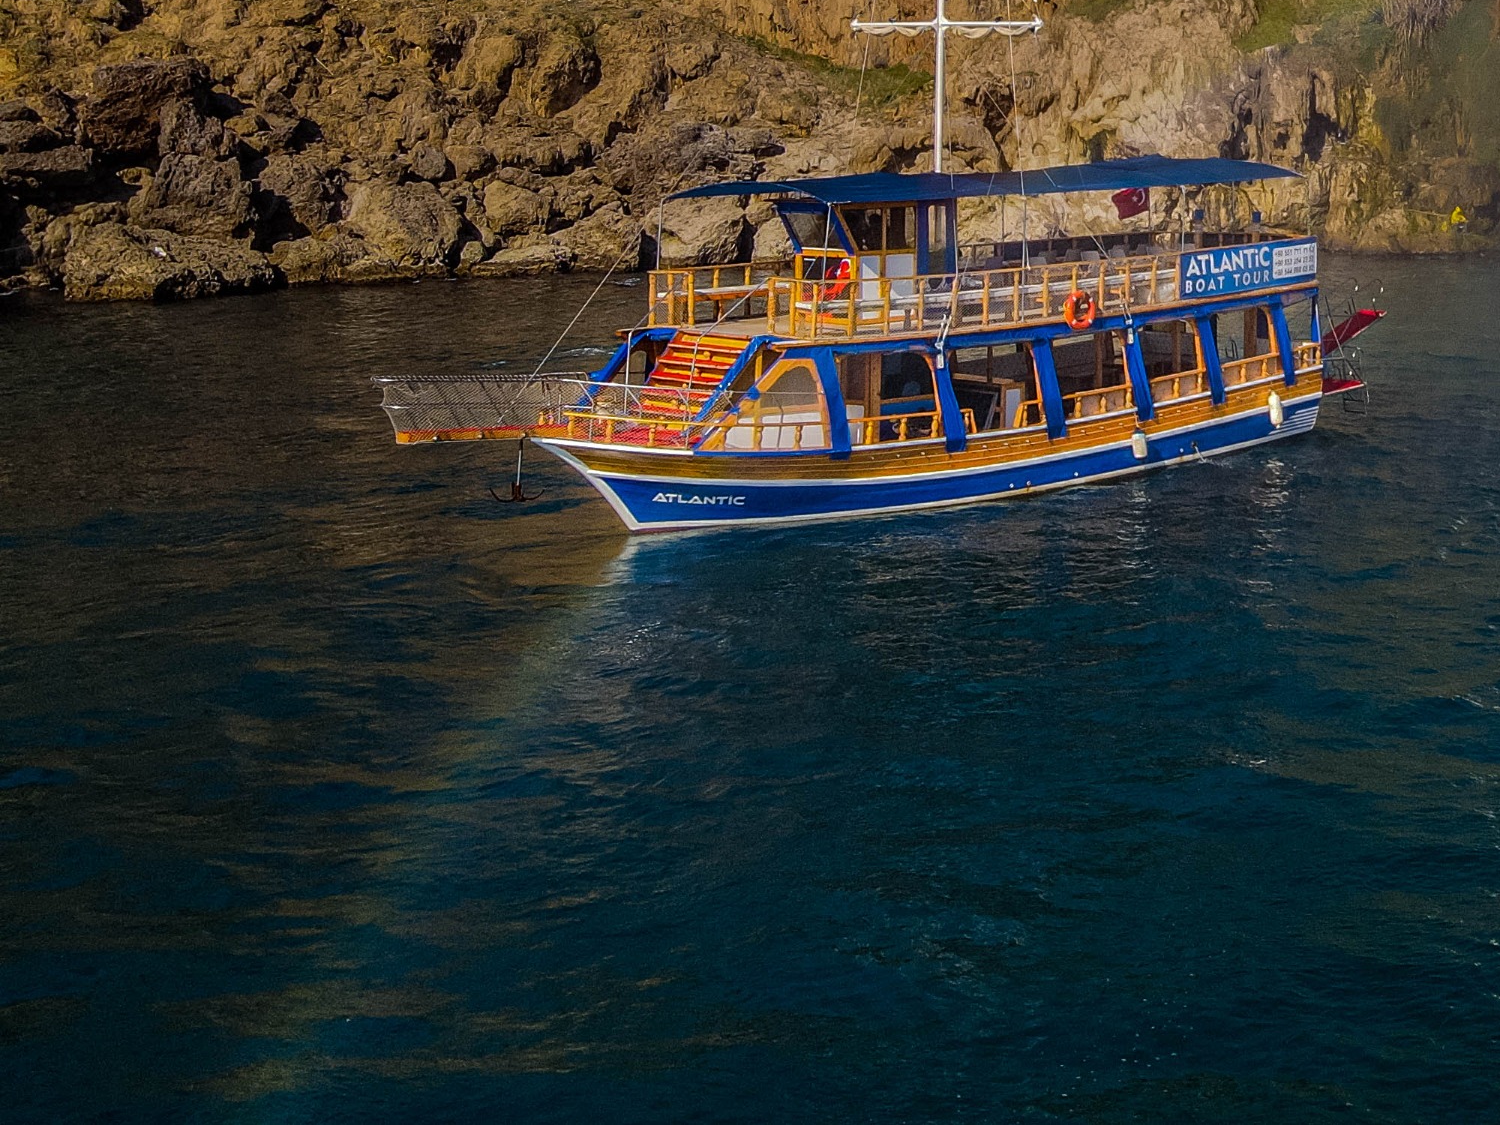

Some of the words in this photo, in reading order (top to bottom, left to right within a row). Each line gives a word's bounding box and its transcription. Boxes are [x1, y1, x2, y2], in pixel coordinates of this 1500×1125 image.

[1185, 277, 1225, 294] BOAT
[1233, 270, 1270, 287] TOUR
[652, 492, 745, 506] ATLANTIC
